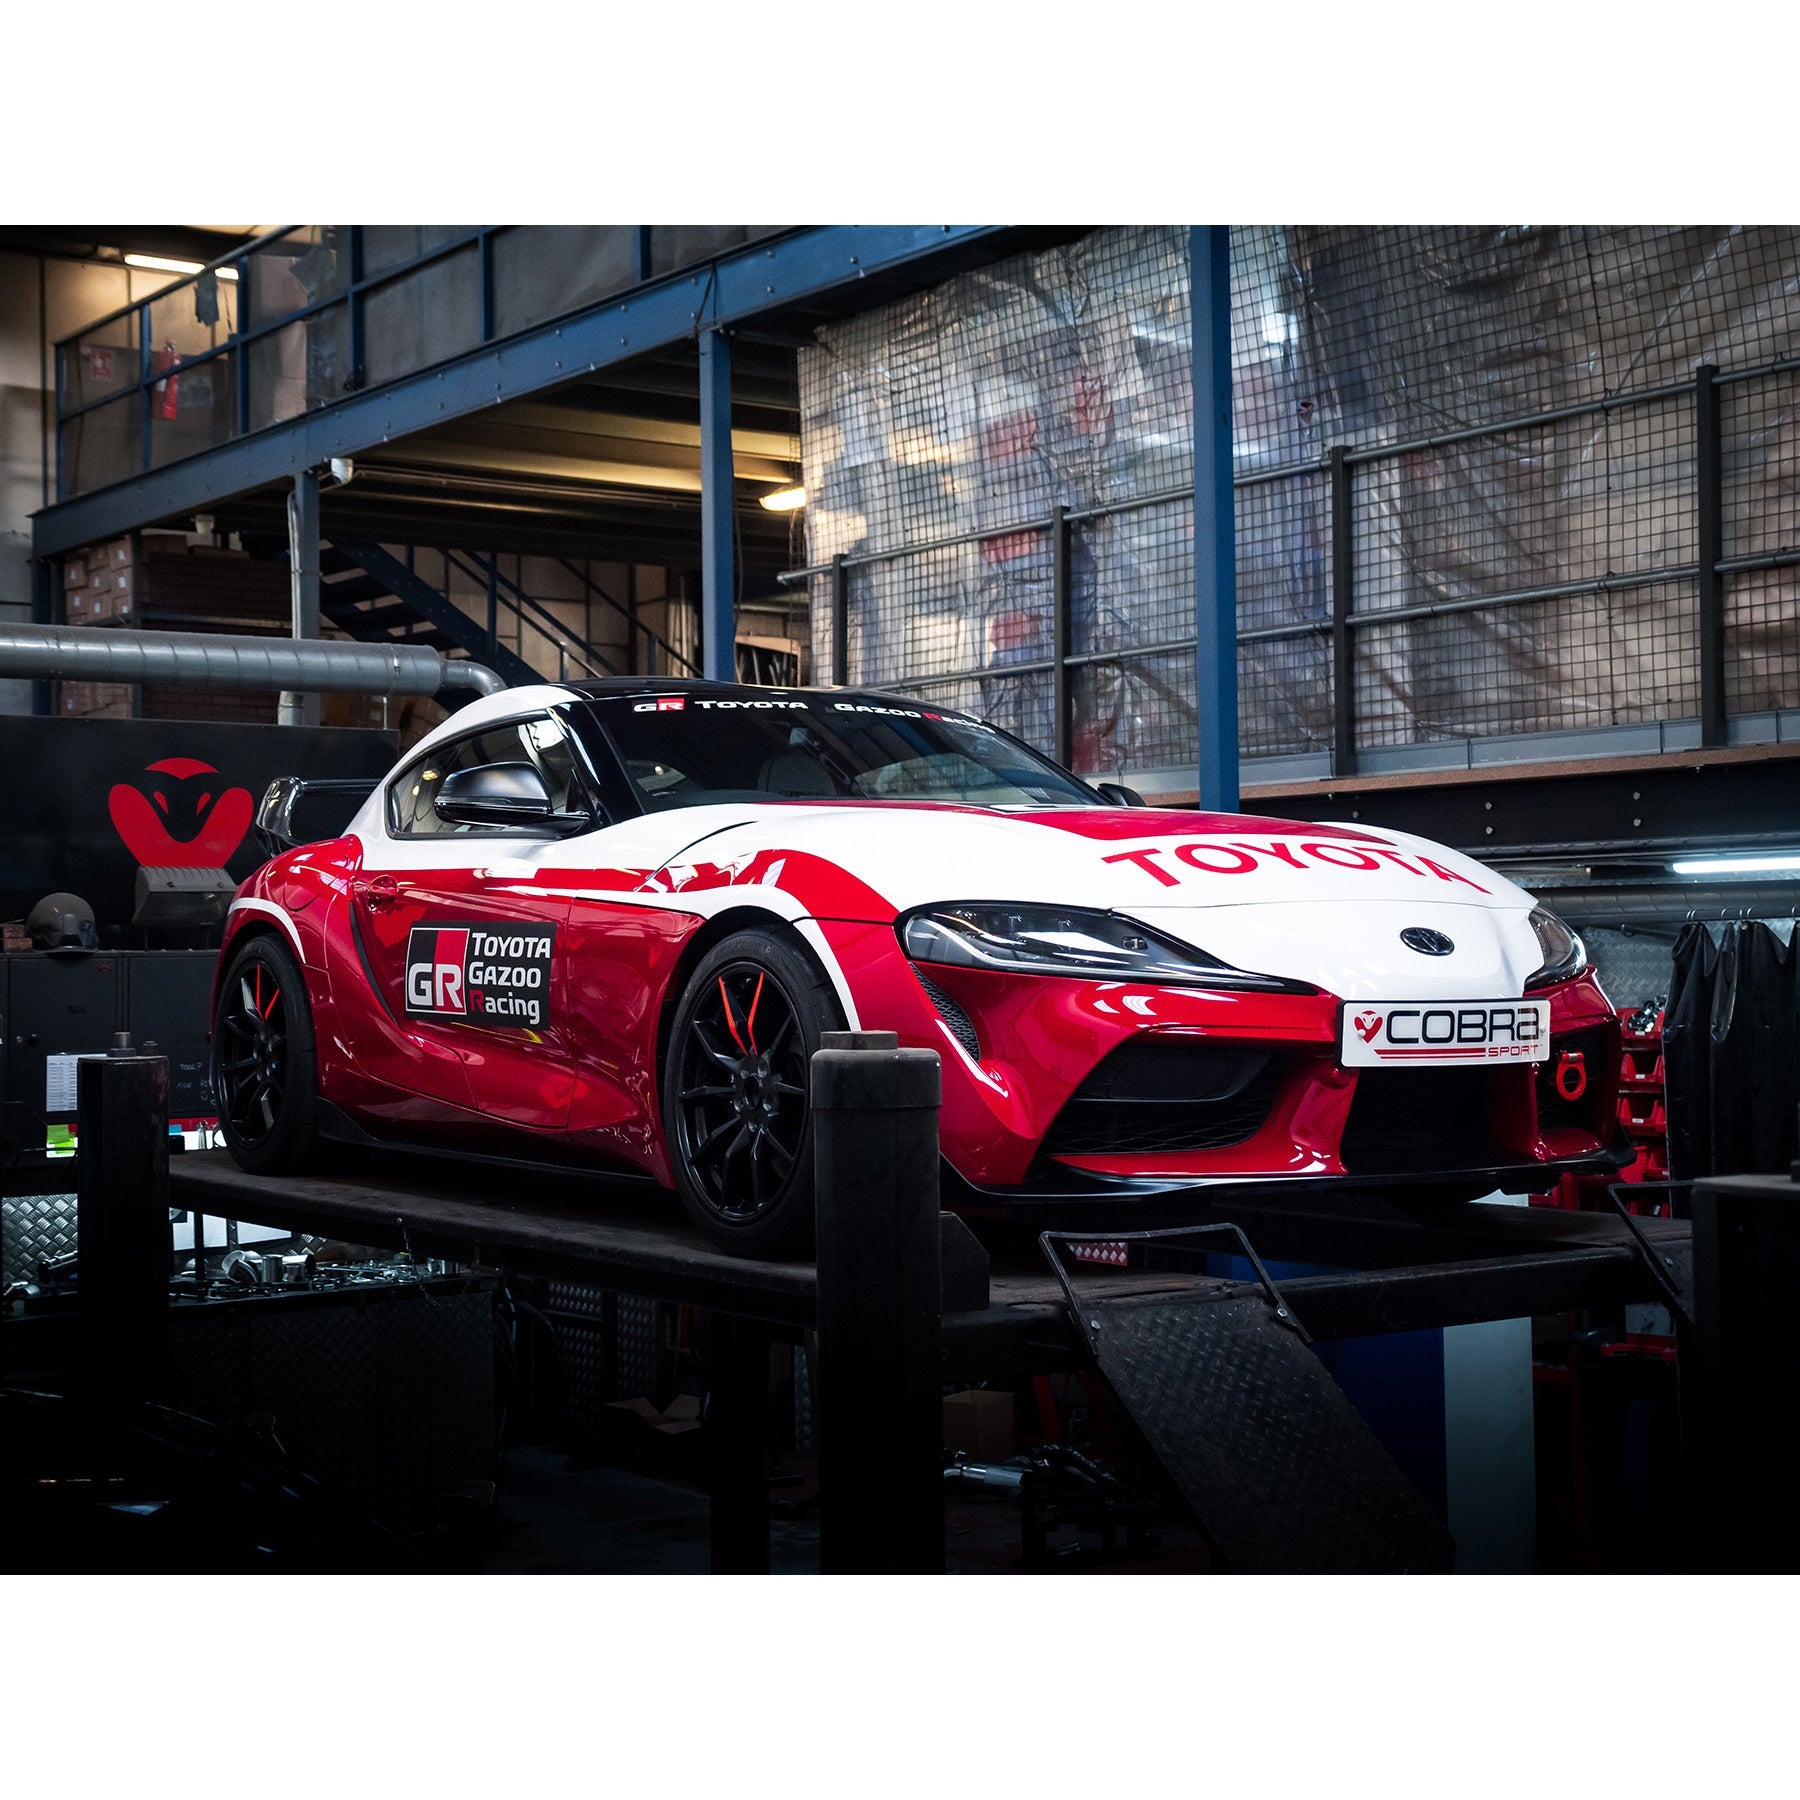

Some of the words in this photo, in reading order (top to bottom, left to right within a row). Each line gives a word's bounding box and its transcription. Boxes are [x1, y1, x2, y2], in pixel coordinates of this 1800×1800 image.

[633, 702, 684, 713] GR
[694, 700, 809, 709] TOYOTA
[833, 703, 922, 718] GAZOO
[1101, 842, 1494, 895] TOYOTA
[472, 932, 551, 959] TOYOTA
[408, 962, 463, 1009] GR
[468, 961, 541, 988] GAZOO
[469, 989, 540, 1025] Racing
[1488, 1044, 1539, 1057] SPORT
